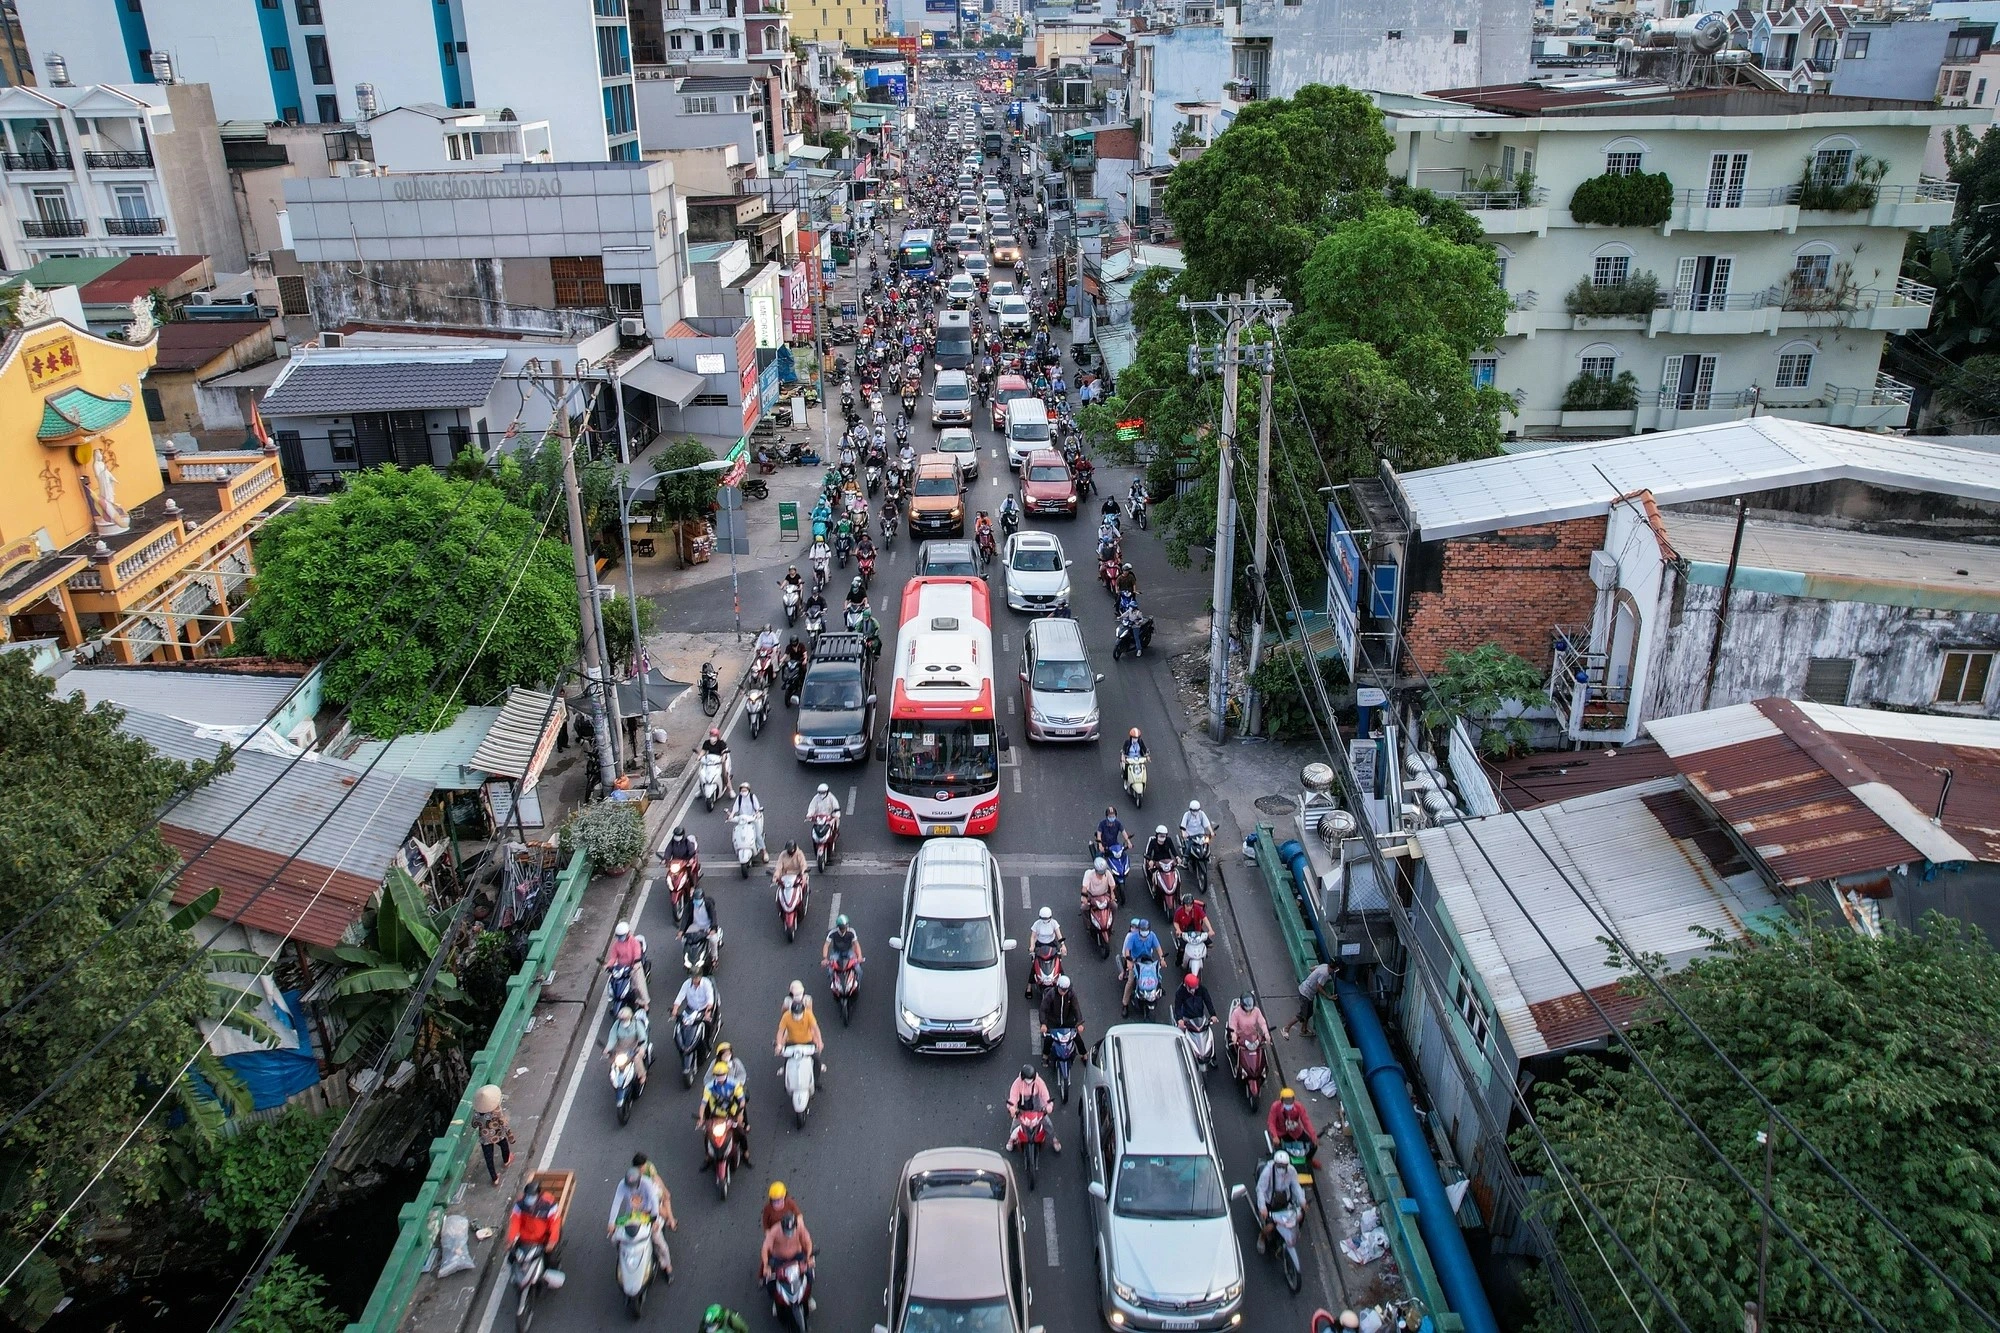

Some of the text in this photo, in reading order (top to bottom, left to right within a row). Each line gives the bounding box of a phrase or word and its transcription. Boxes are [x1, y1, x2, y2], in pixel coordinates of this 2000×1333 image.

[441, 176, 470, 200] CÁO
[471, 178, 521, 198] MINH
[522, 177, 562, 201] ĐẠO
[822, 261, 835, 270] VIỆT
[822, 270, 836, 278] TIẾN
